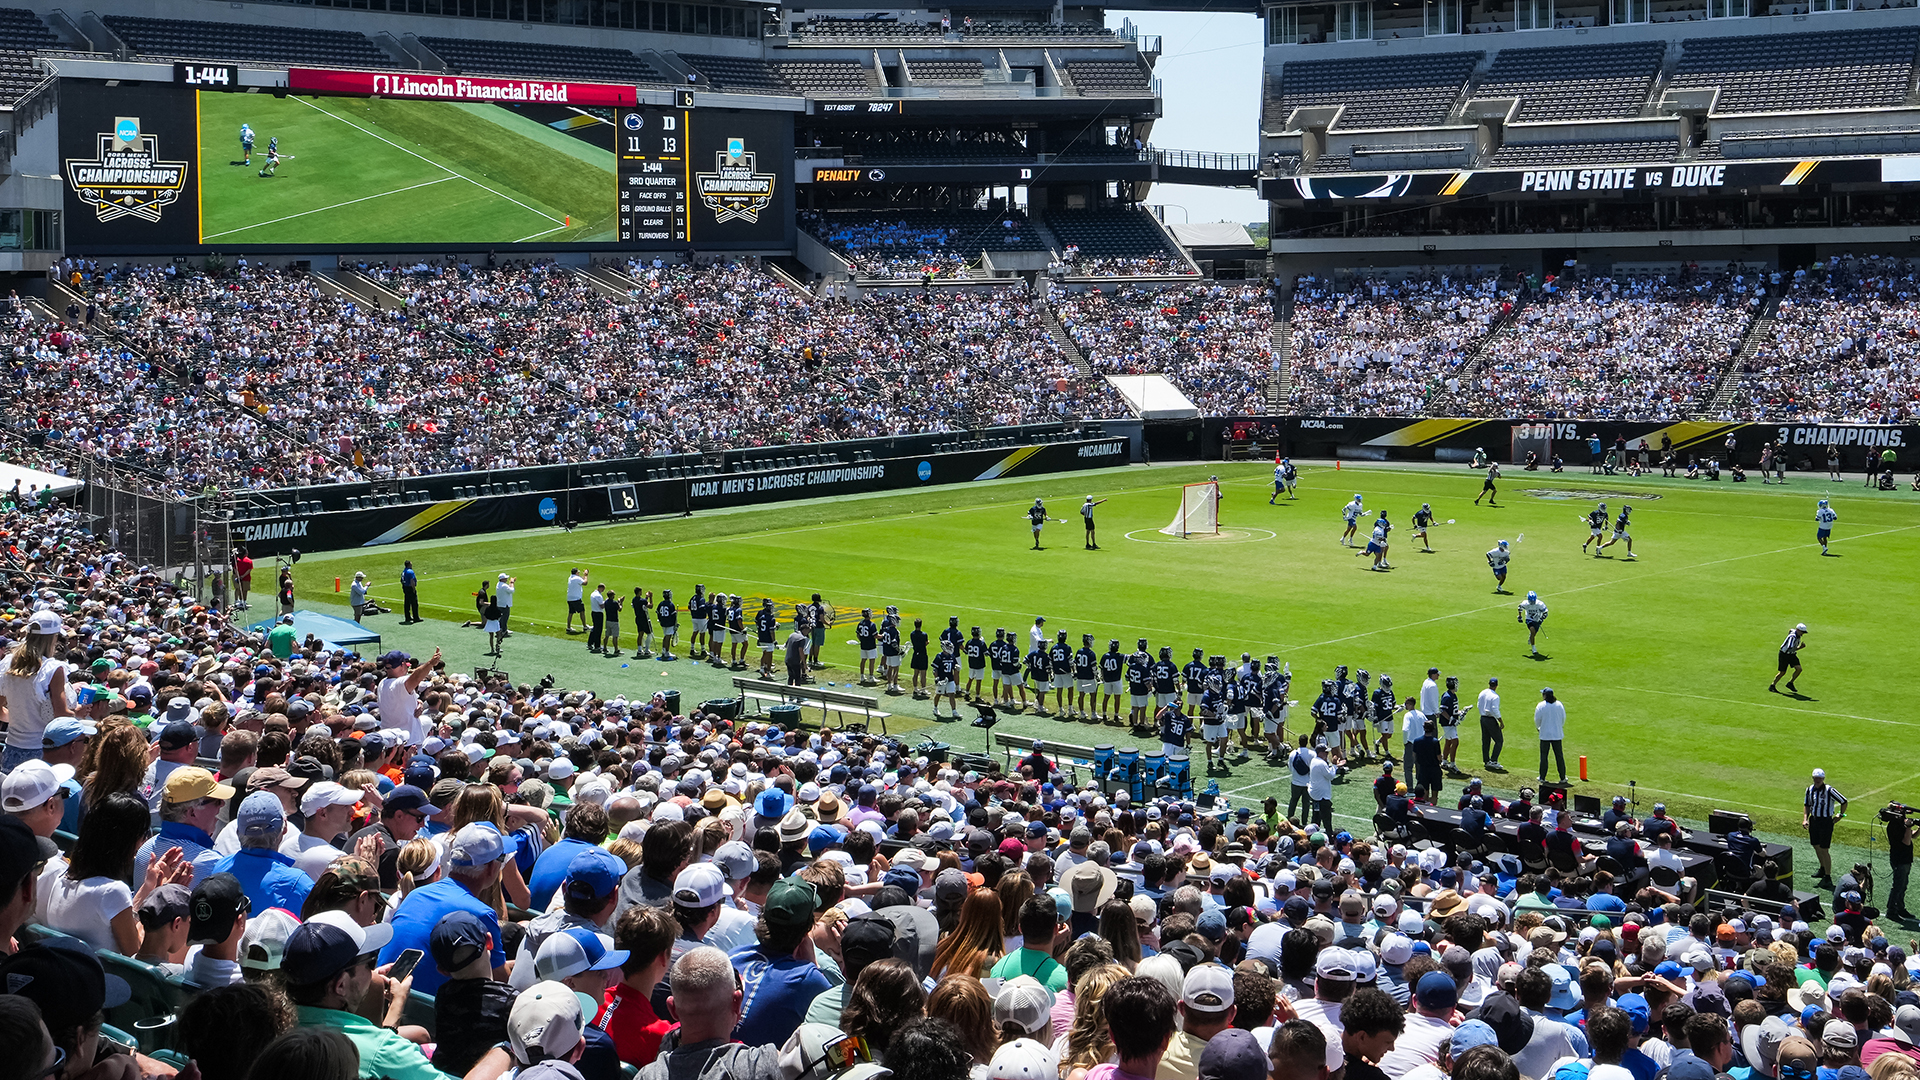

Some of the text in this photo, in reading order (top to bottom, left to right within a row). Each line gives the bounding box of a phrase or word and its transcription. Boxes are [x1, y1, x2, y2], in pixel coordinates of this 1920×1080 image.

[185, 65, 230, 86] 1:44
[392, 75, 568, 103] Lincoln Financial Field
[867, 103, 894, 112] 78247
[662, 116, 676, 131] D
[628, 136, 677, 153] 11 13
[103, 157, 152, 169] LACROSSE
[642, 162, 663, 173] 1:44
[78, 168, 178, 184] CHAMPIONSHIPS
[720, 171, 752, 180] LACROSSE
[816, 169, 861, 182] PENALTY
[1020, 168, 1032, 179] D
[1521, 170, 1574, 192] PENN
[1577, 168, 1637, 190] STATE
[1670, 165, 1727, 188] DUKE
[629, 176, 677, 187] 3RD QUARTER
[703, 179, 769, 192] CHAMPIONSHIPS
[621, 191, 630, 199] 12
[676, 191, 684, 199] 15
[634, 205, 655, 213] GROUND
[656, 205, 672, 213] BALLS
[621, 218, 684, 226] 14 CLEARS 11
[638, 232, 669, 240] TURNOVERS
[1300, 419, 1344, 430] NCAA.com
[1518, 422, 1581, 440] 3 DAYS.
[1776, 426, 1906, 448] 3 CHAMPIONS.
[1077, 442, 1123, 458] #NCAAMLAX
[691, 465, 885, 498] NCAA MEN'S LACROSSE CHAMPIONSHIPS
[1821, 512, 1834, 523] 13
[231, 520, 310, 542] CAAMLAX
[659, 605, 670, 617] 46
[760, 620, 767, 632] 5
[859, 625, 869, 637] 36
[967, 645, 980, 658] 29
[1001, 650, 1012, 663] 21
[1052, 648, 1065, 662] 26
[1032, 655, 1043, 670] 14
[1076, 653, 1088, 667] 30
[1103, 658, 1118, 672] 40
[943, 661, 953, 673] 31
[1156, 666, 1169, 680] 25
[1189, 667, 1202, 680] 17
[1129, 669, 1142, 684] 52
[1320, 701, 1337, 716] 42
[1170, 722, 1184, 736] 38
